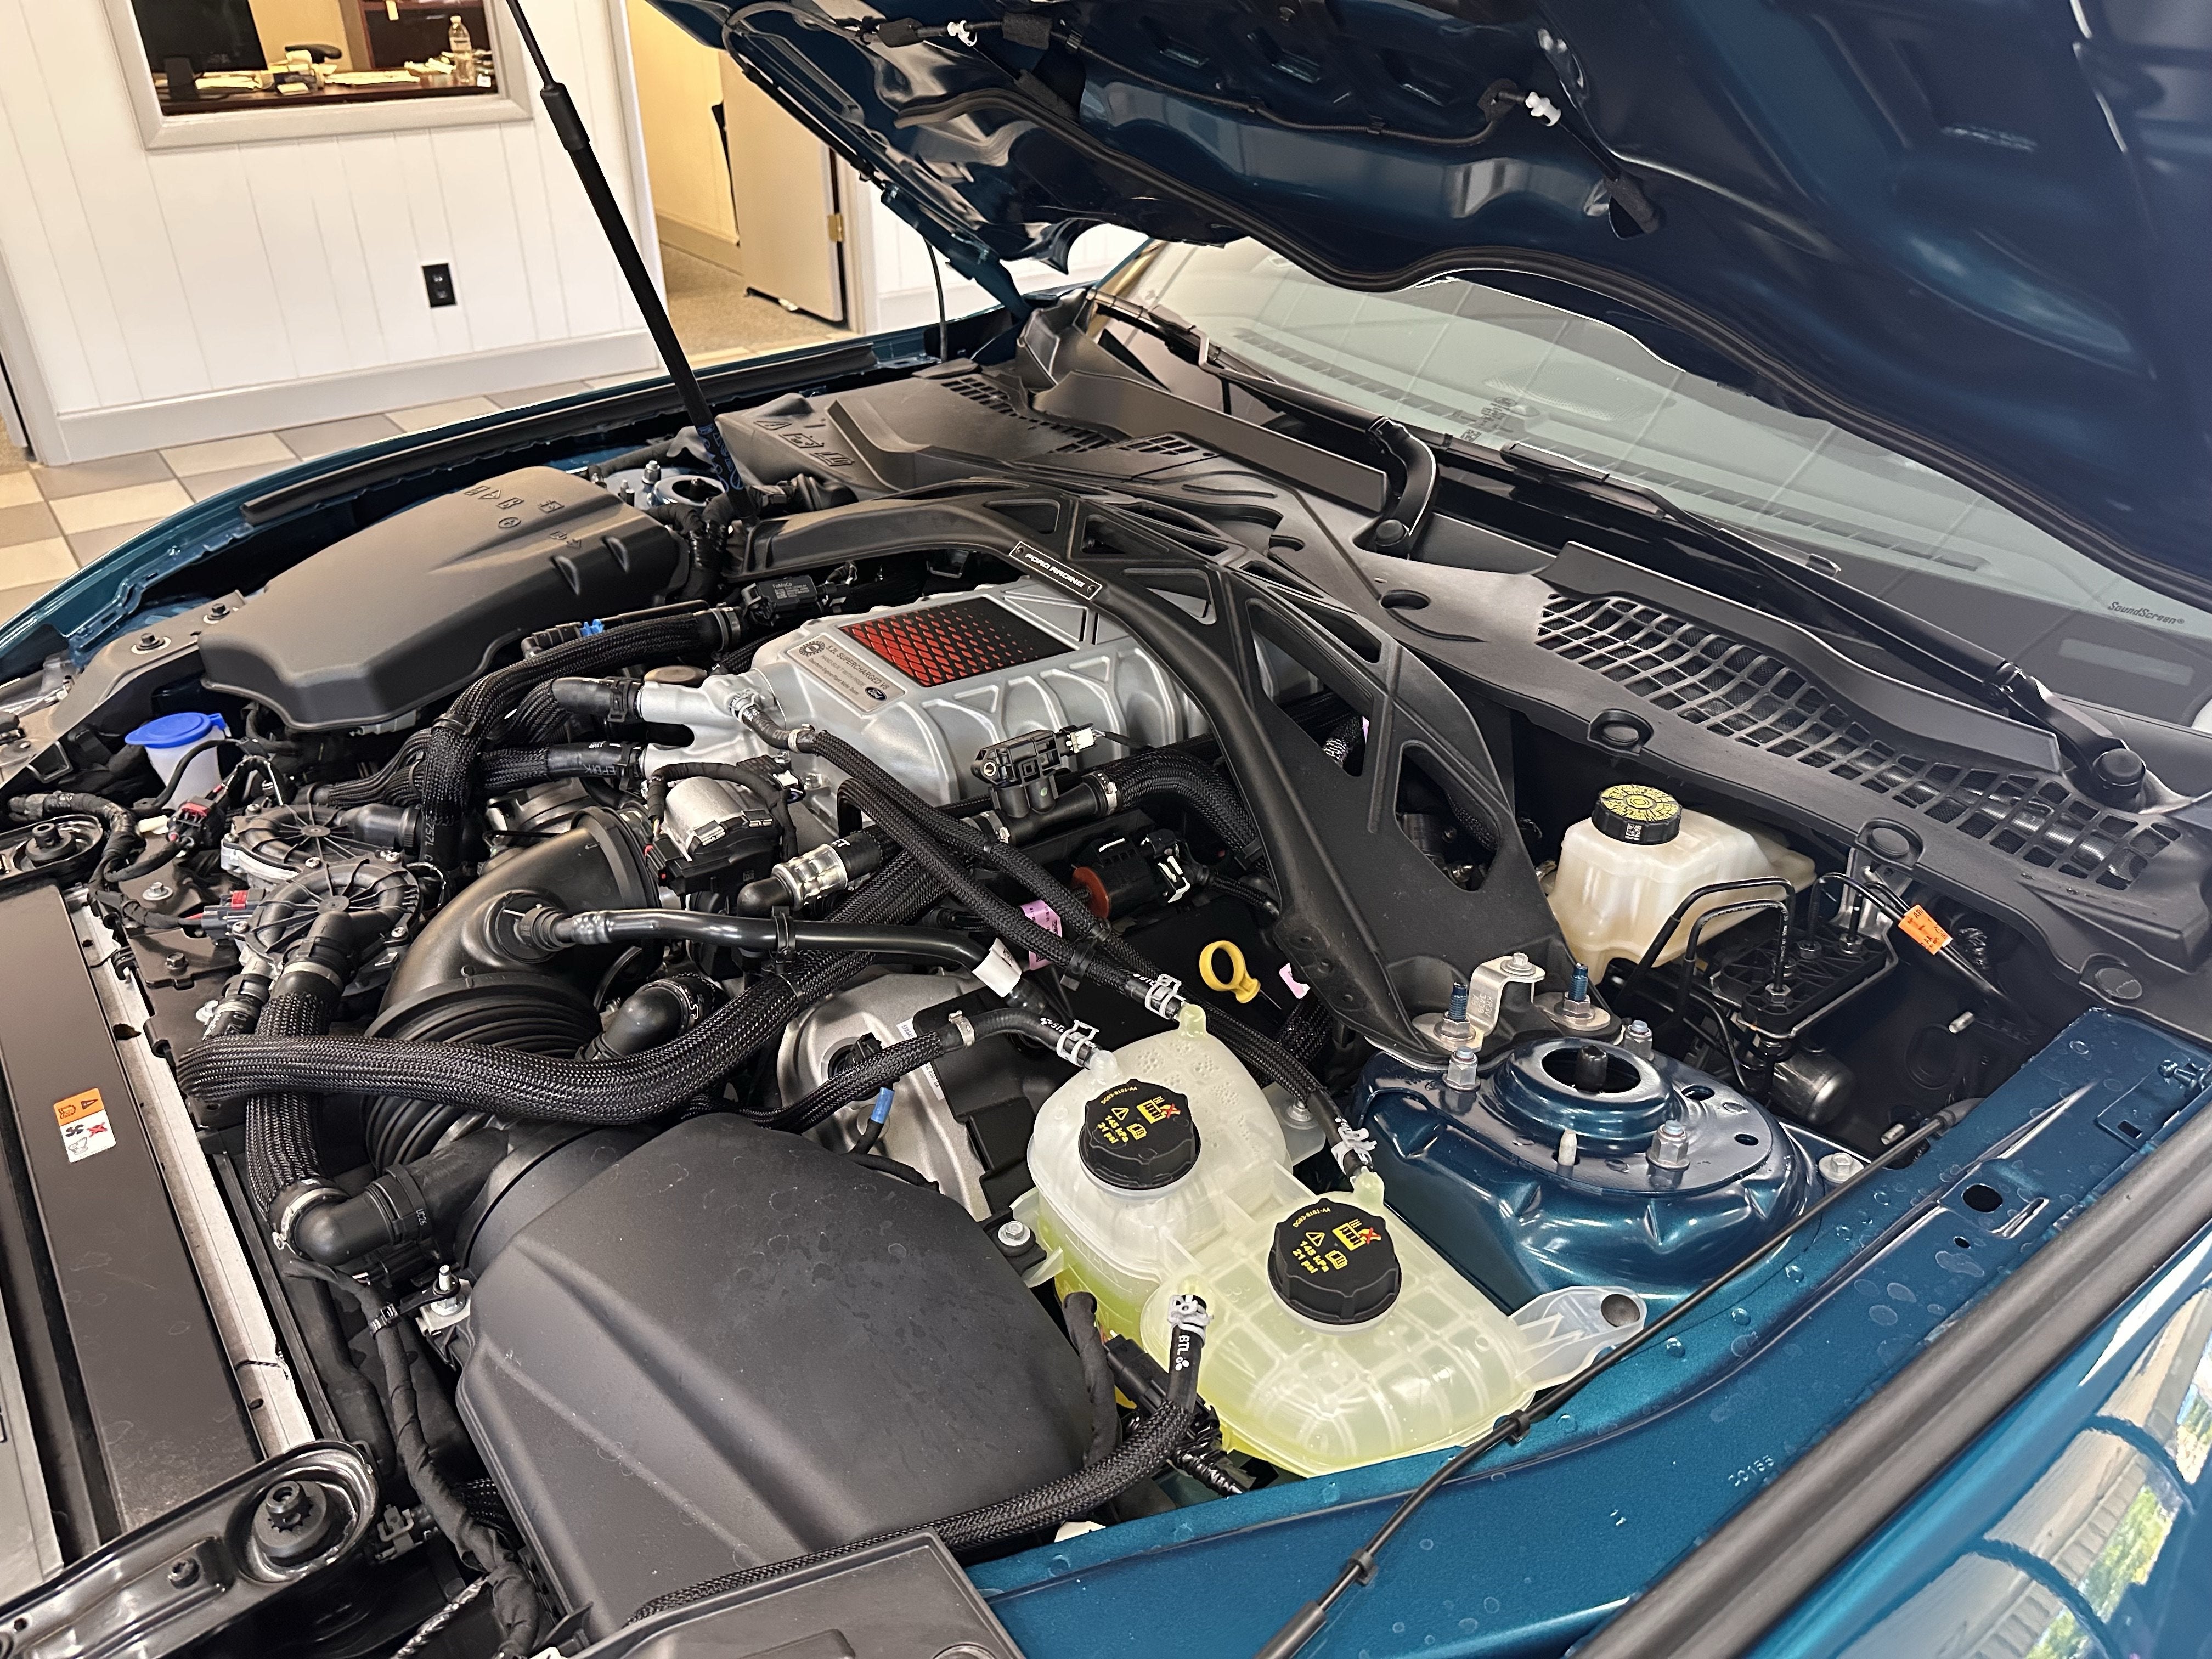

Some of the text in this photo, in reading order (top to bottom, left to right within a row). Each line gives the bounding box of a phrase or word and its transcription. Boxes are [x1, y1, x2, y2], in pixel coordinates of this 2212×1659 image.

[1025, 553, 1085, 588] FORD RACING
[826, 645, 837, 655] 5.2L
[836, 653, 882, 685] SUPERCHARGED
[880, 682, 890, 690] V8
[1097, 1122, 1119, 1144] 21 psi
[1105, 1115, 1119, 1129] 145
[1300, 1240, 1317, 1256] 145
[1292, 1249, 1318, 1274] 21 psi
